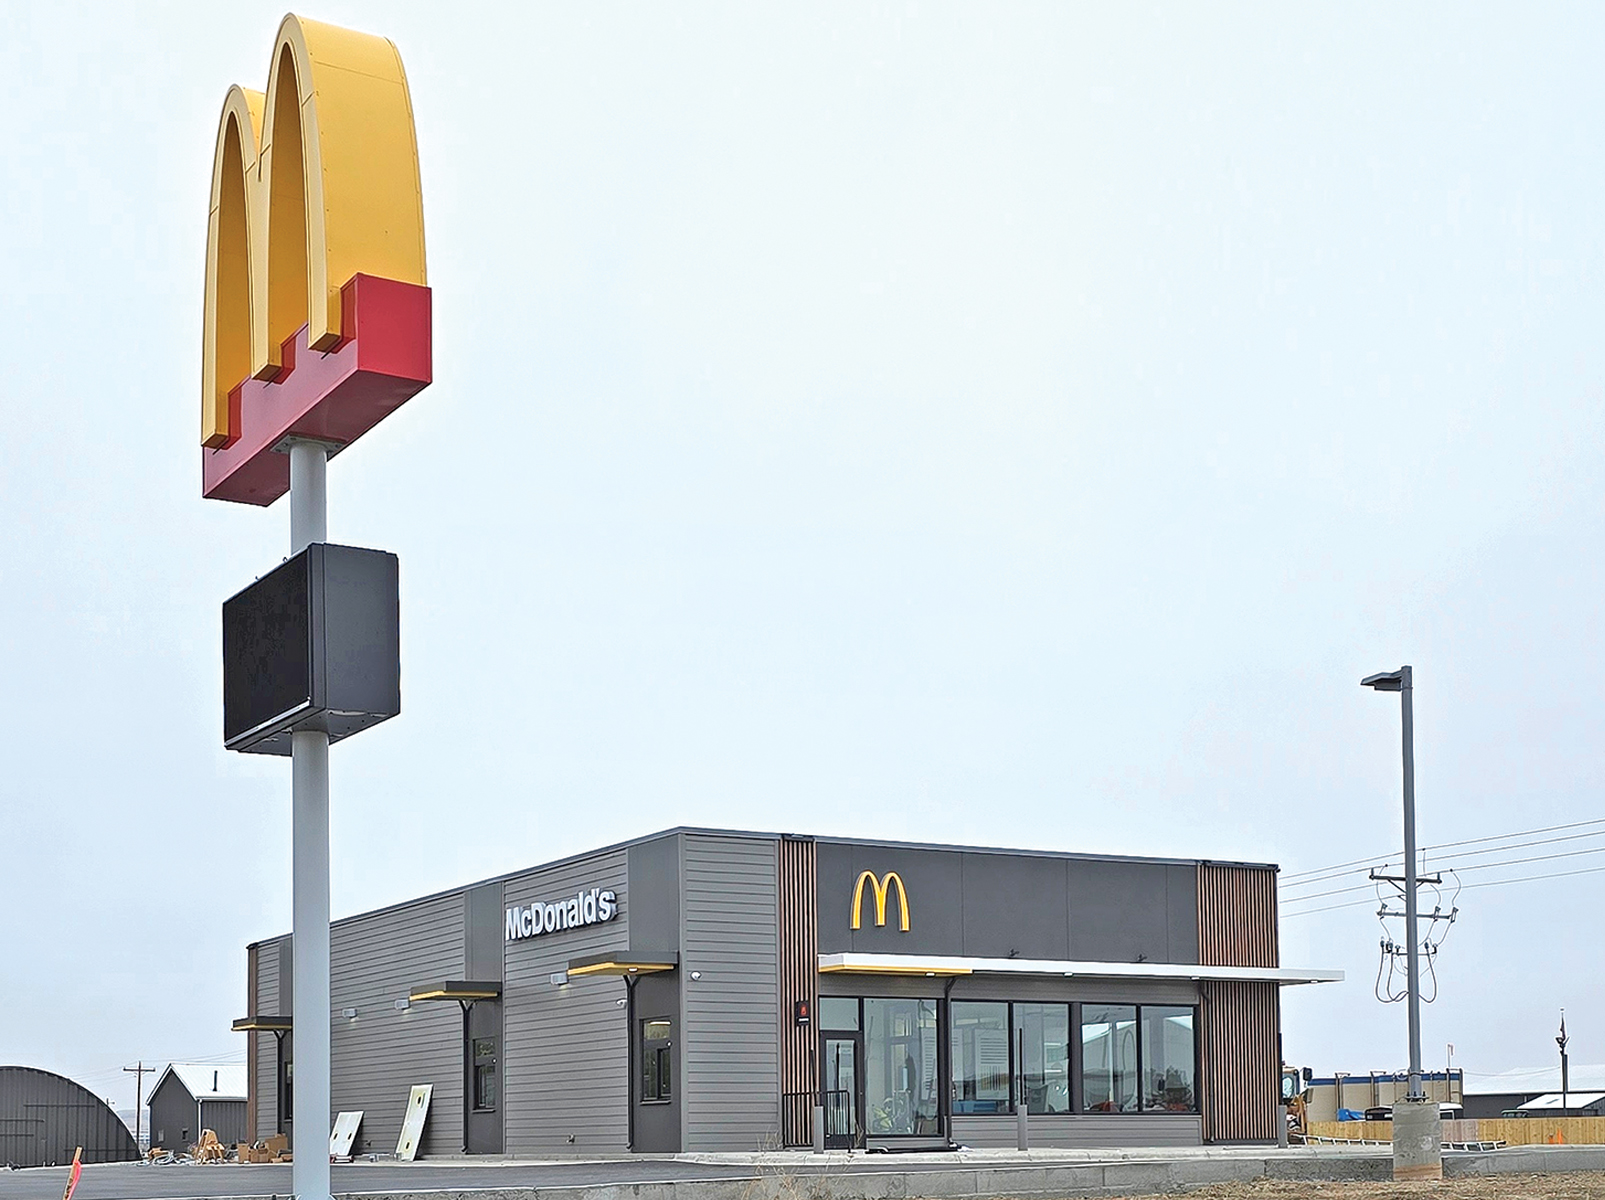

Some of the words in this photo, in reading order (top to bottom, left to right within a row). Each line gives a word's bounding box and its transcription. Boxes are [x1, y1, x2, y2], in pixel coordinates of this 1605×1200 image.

[201, 12, 427, 450] M
[505, 887, 618, 941] McDonald's
[850, 869, 911, 932] M
